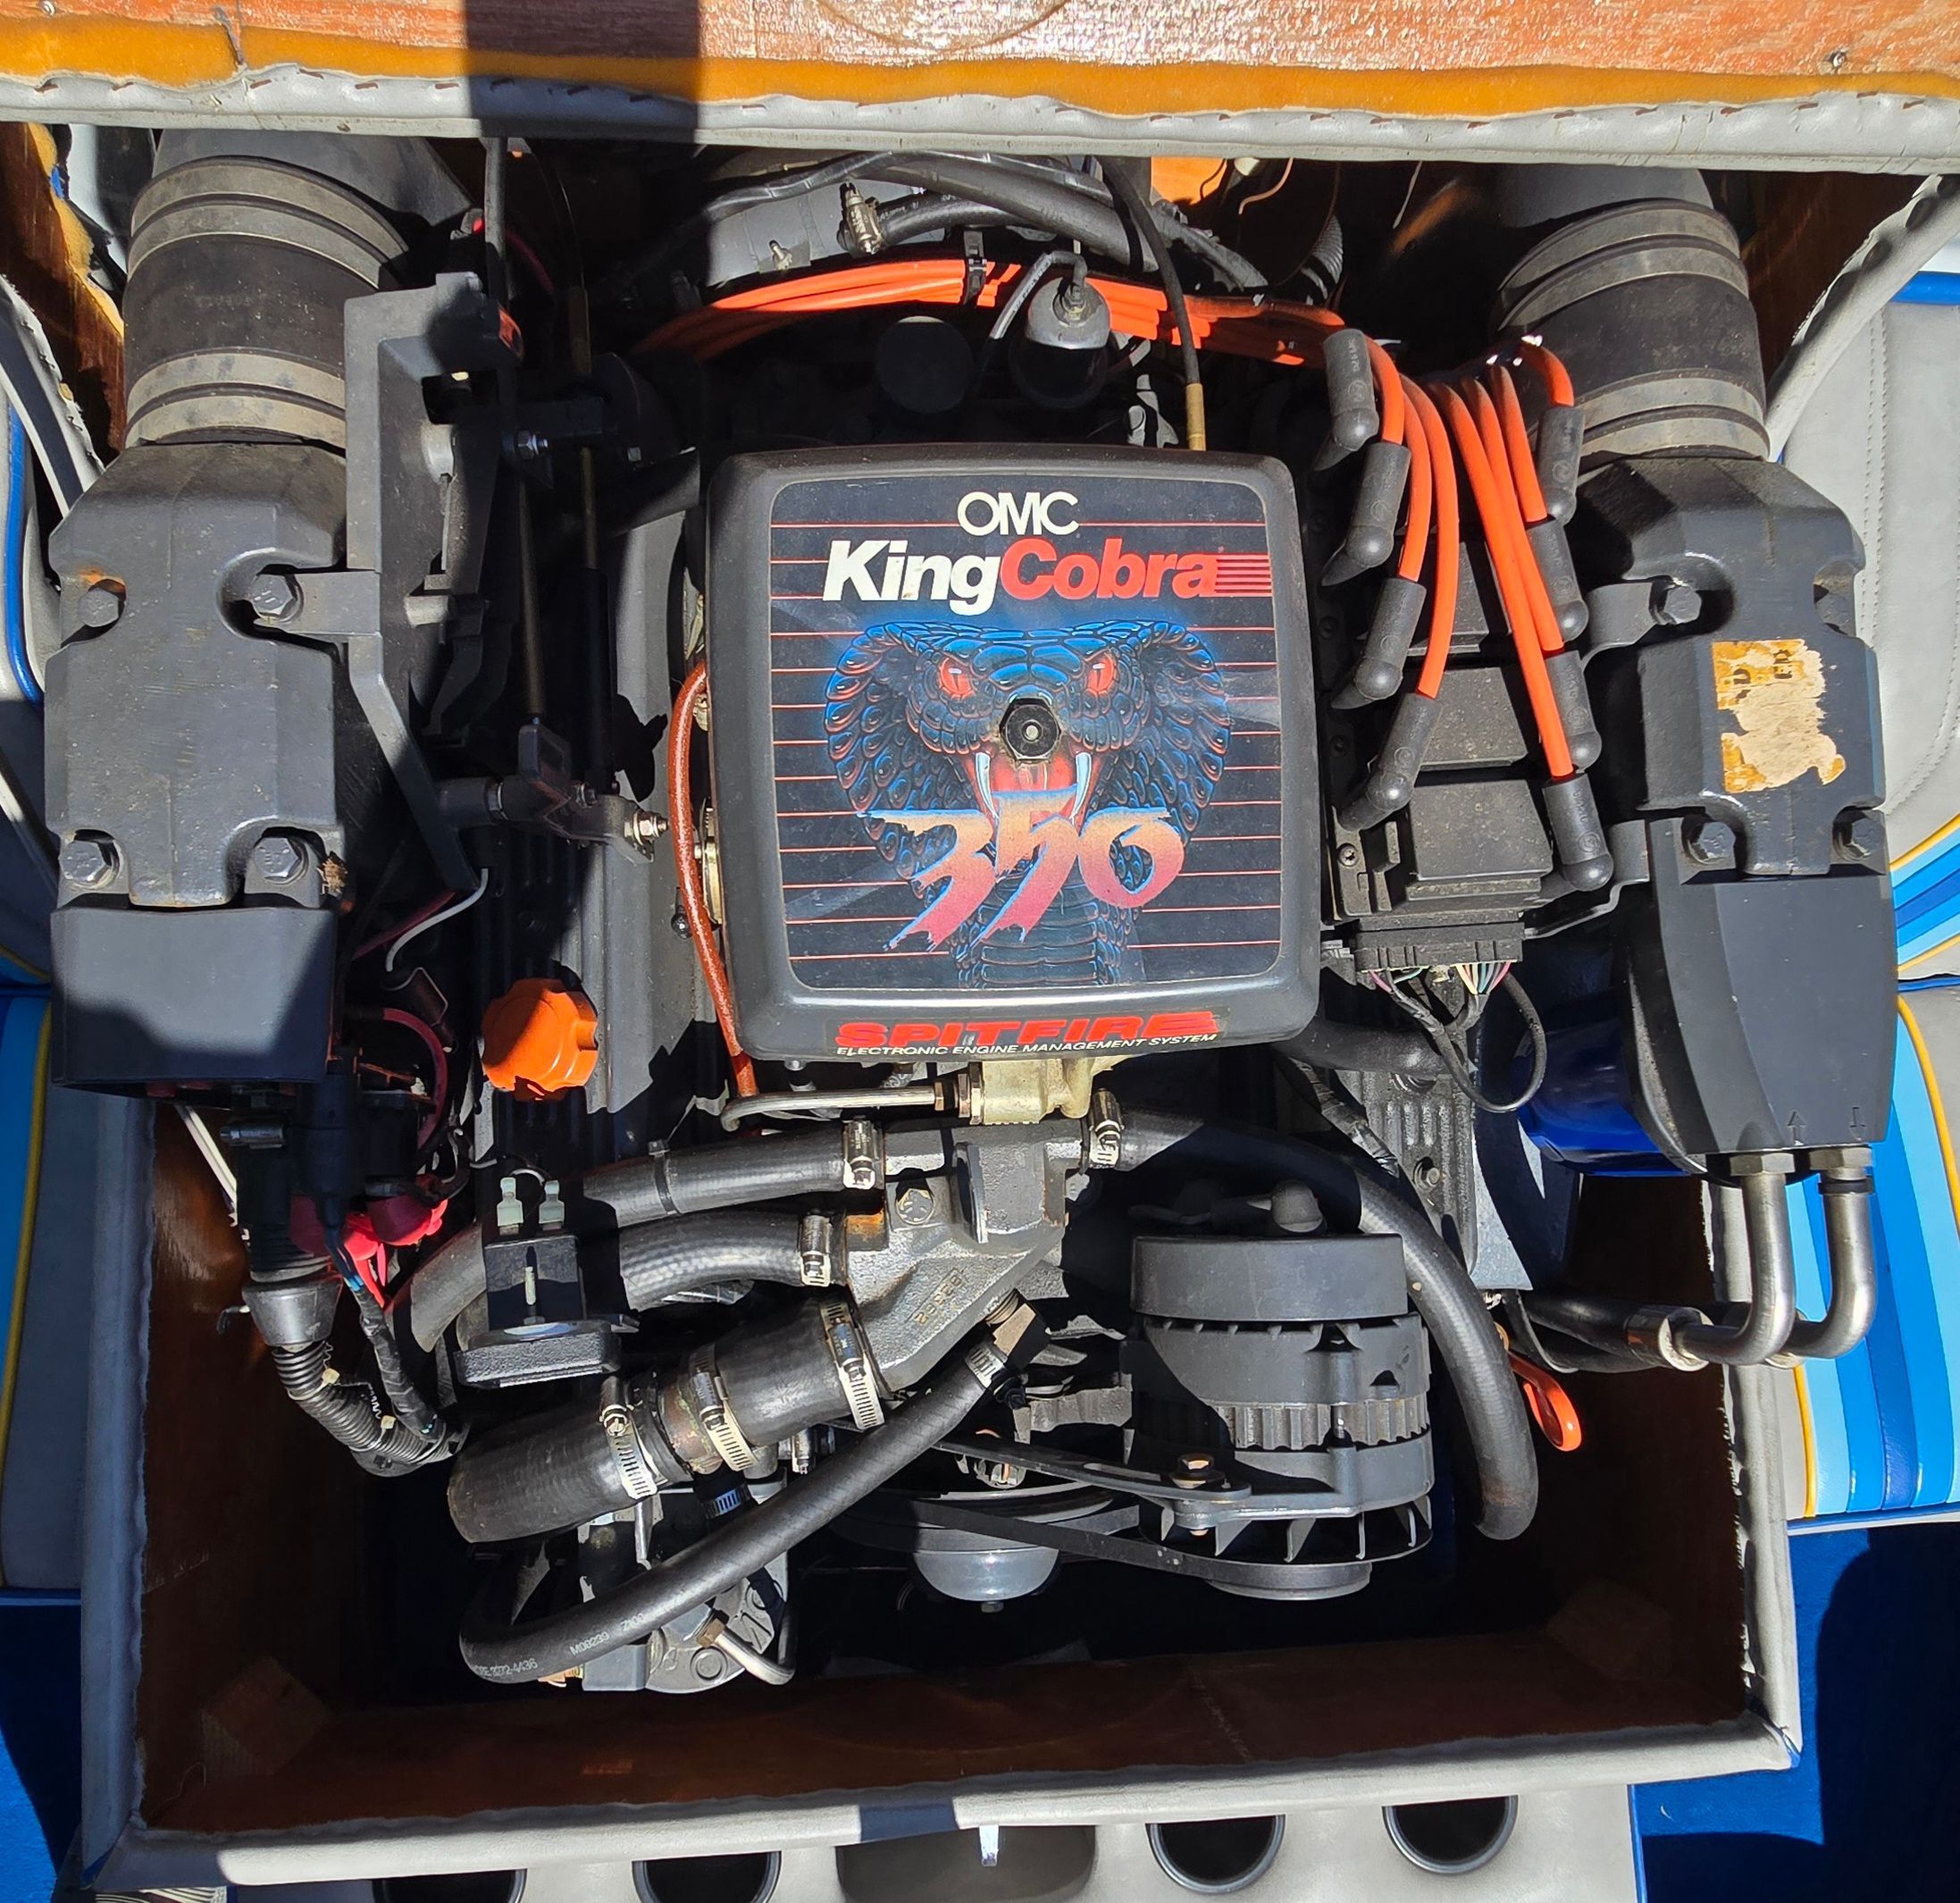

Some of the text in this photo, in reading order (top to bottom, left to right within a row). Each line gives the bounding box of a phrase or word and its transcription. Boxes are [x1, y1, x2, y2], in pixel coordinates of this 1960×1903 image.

[957, 491, 1080, 536] OMC
[835, 1011, 1219, 1047] SPITFIRE
[836, 1034, 1219, 1057] ELECTRONIC ENGINE MANAGEMENT SYSTEM
